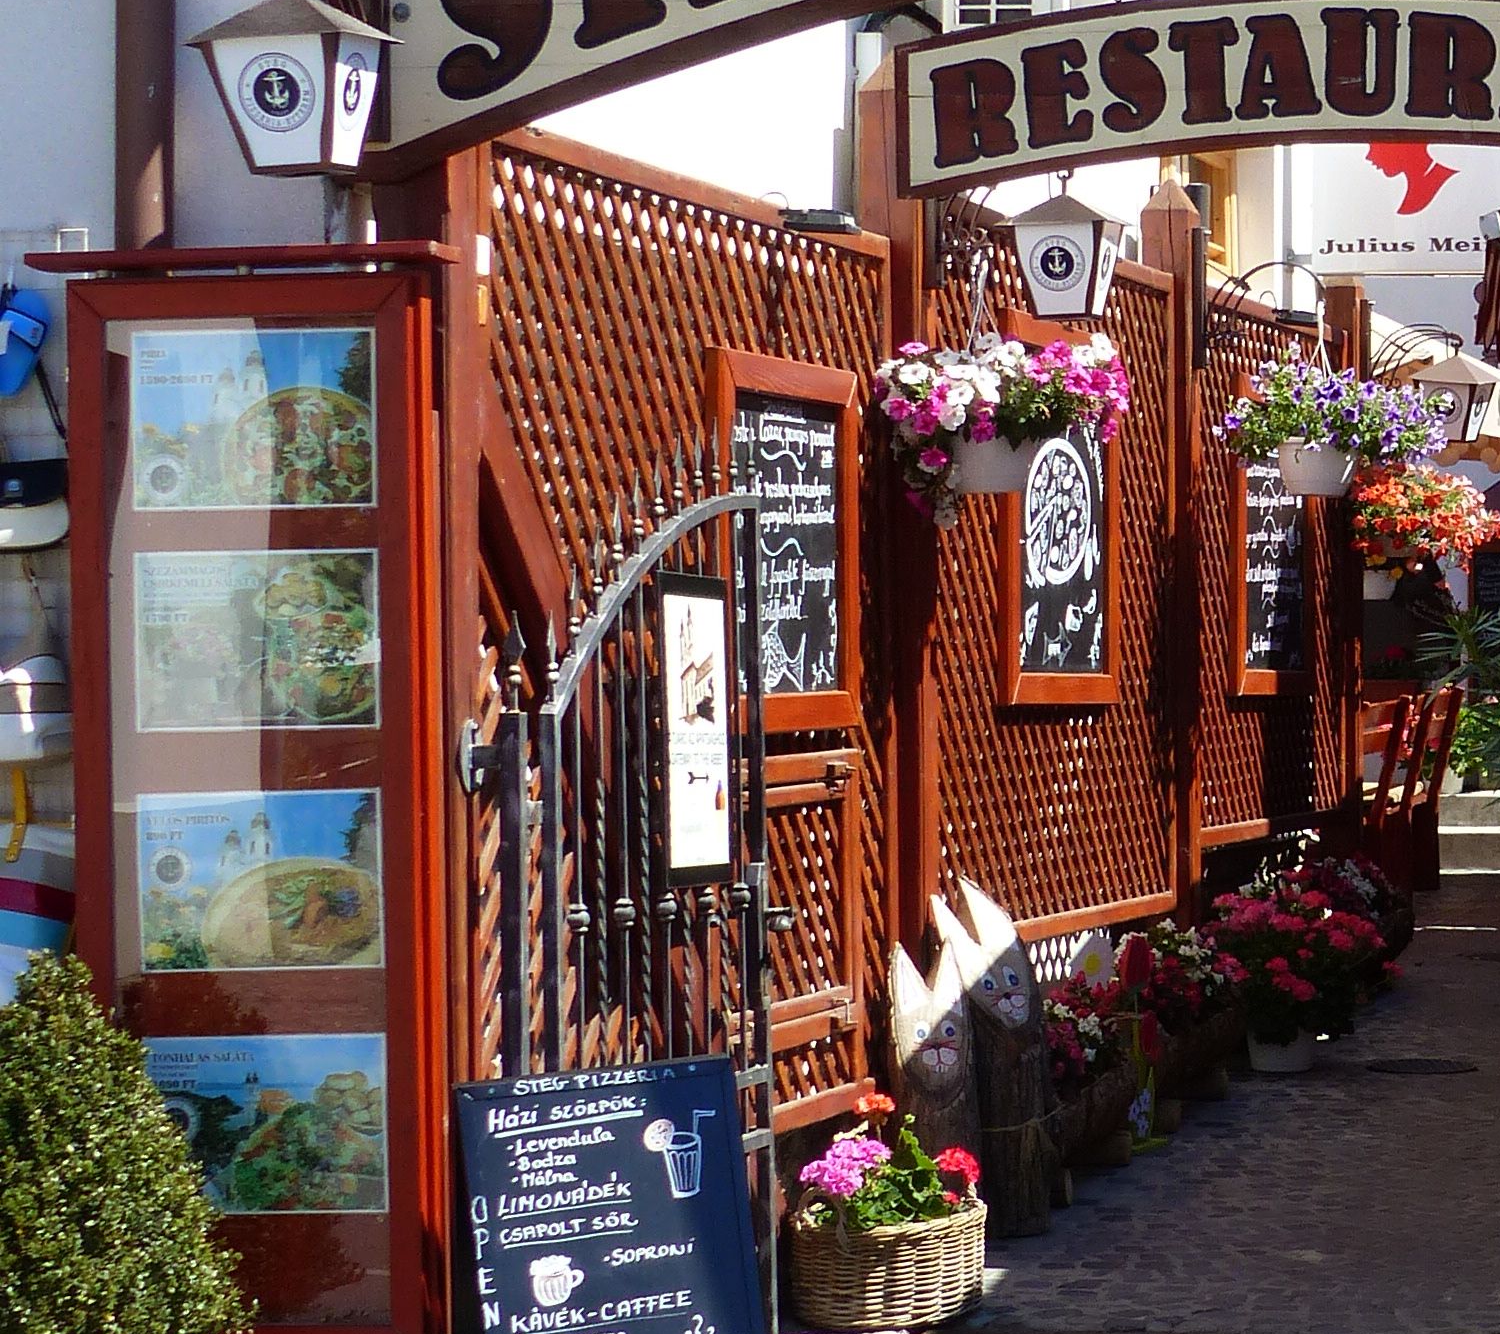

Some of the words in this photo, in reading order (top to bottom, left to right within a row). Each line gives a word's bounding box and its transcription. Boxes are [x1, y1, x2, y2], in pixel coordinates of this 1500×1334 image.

[1319, 238, 1415, 255] Julius
[1428, 237, 1488, 252] Mei
[515, 1126, 615, 1156] Levendula
[517, 1151, 577, 1171] Bodza
[521, 1169, 579, 1188] Málna
[500, 1218, 586, 1244] CSAPOLT
